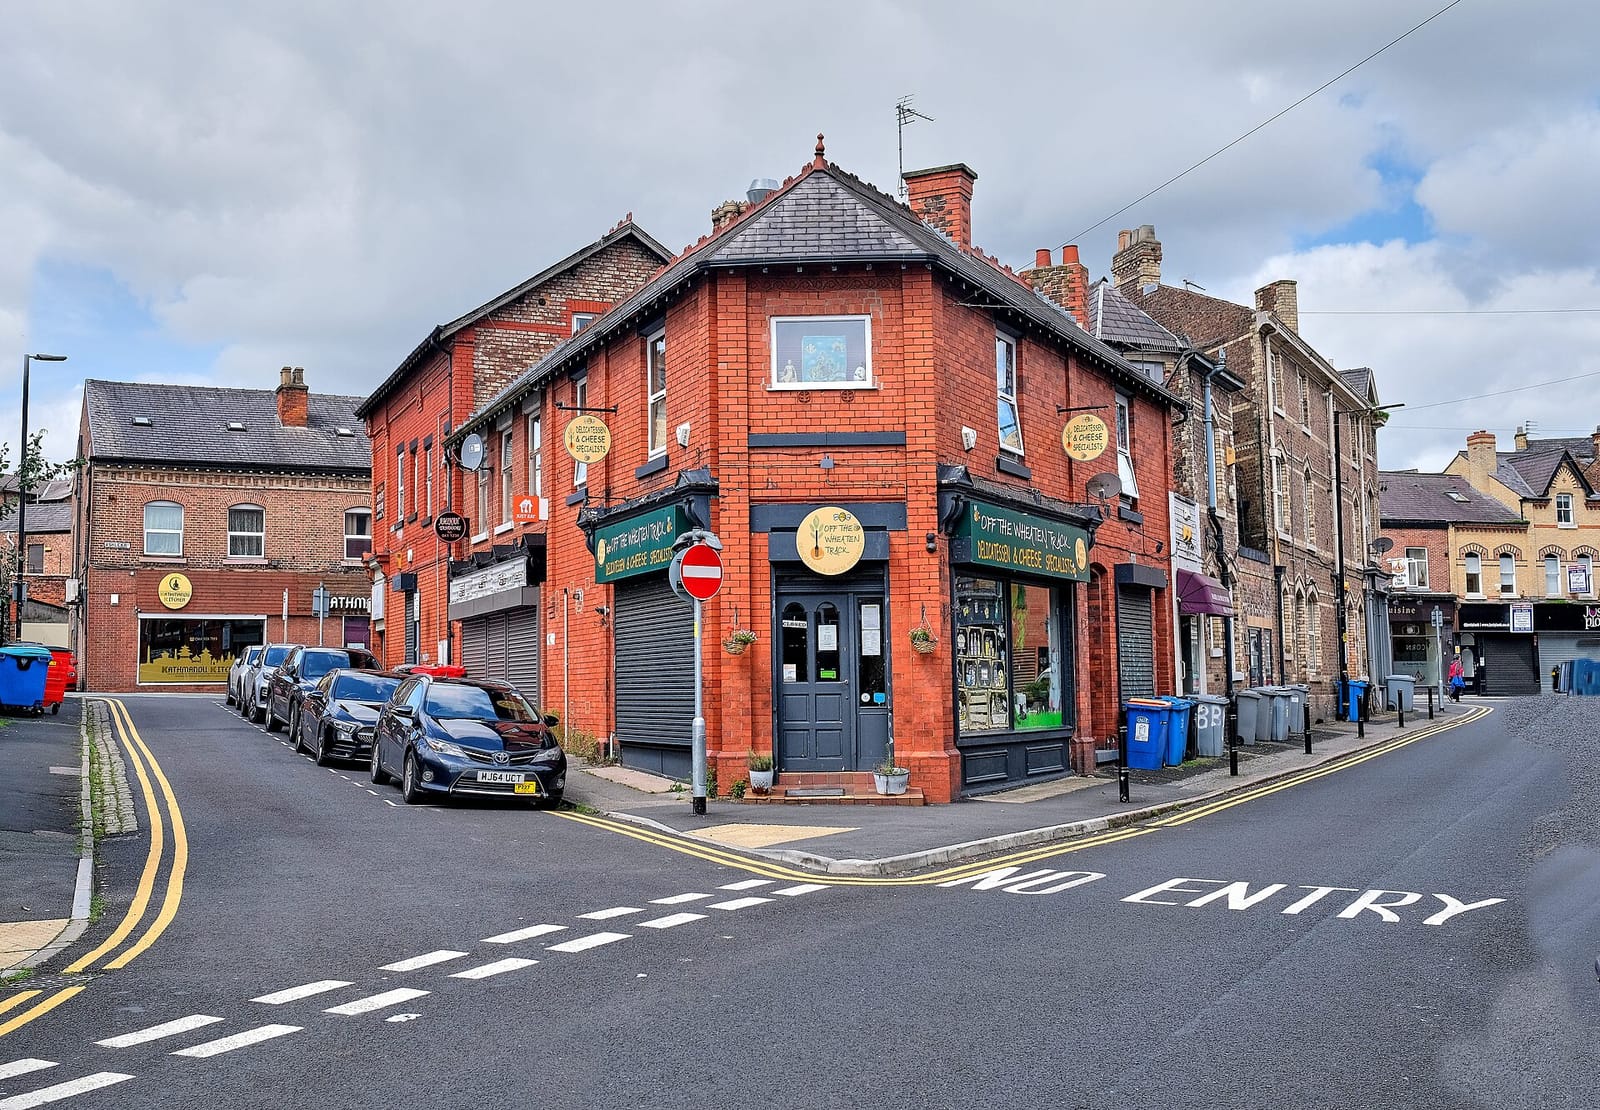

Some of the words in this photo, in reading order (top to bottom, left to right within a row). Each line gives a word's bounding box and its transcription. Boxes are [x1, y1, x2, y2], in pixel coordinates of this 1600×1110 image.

[581, 436, 606, 444] CHEESE
[1079, 433, 1102, 442] CHEESE
[576, 445, 606, 453] SPECIALISTS
[1072, 442, 1103, 451] SPECIALISTS
[824, 524, 837, 532] OFF
[619, 532, 628, 548] THE
[628, 524, 650, 547] WHEATEN
[981, 516, 996, 533] OFF
[996, 518, 1012, 536] THE
[1013, 522, 1048, 549] WHEATEN
[1048, 530, 1071, 552] TRACK
[824, 534, 860, 545] WHEATEN
[825, 546, 850, 556] TRACK
[630, 552, 647, 568] CHEESE
[650, 547, 673, 564] SPECIALISTS
[978, 540, 1010, 563] DELICATESSEN
[1013, 547, 1018, 563] &
[1018, 548, 1042, 568] CHEESE
[1046, 554, 1074, 574] SPECIALISTS
[506, 774, 522, 782] UCT
[936, 867, 1106, 894] NO
[1120, 878, 1507, 926] ENTRY
